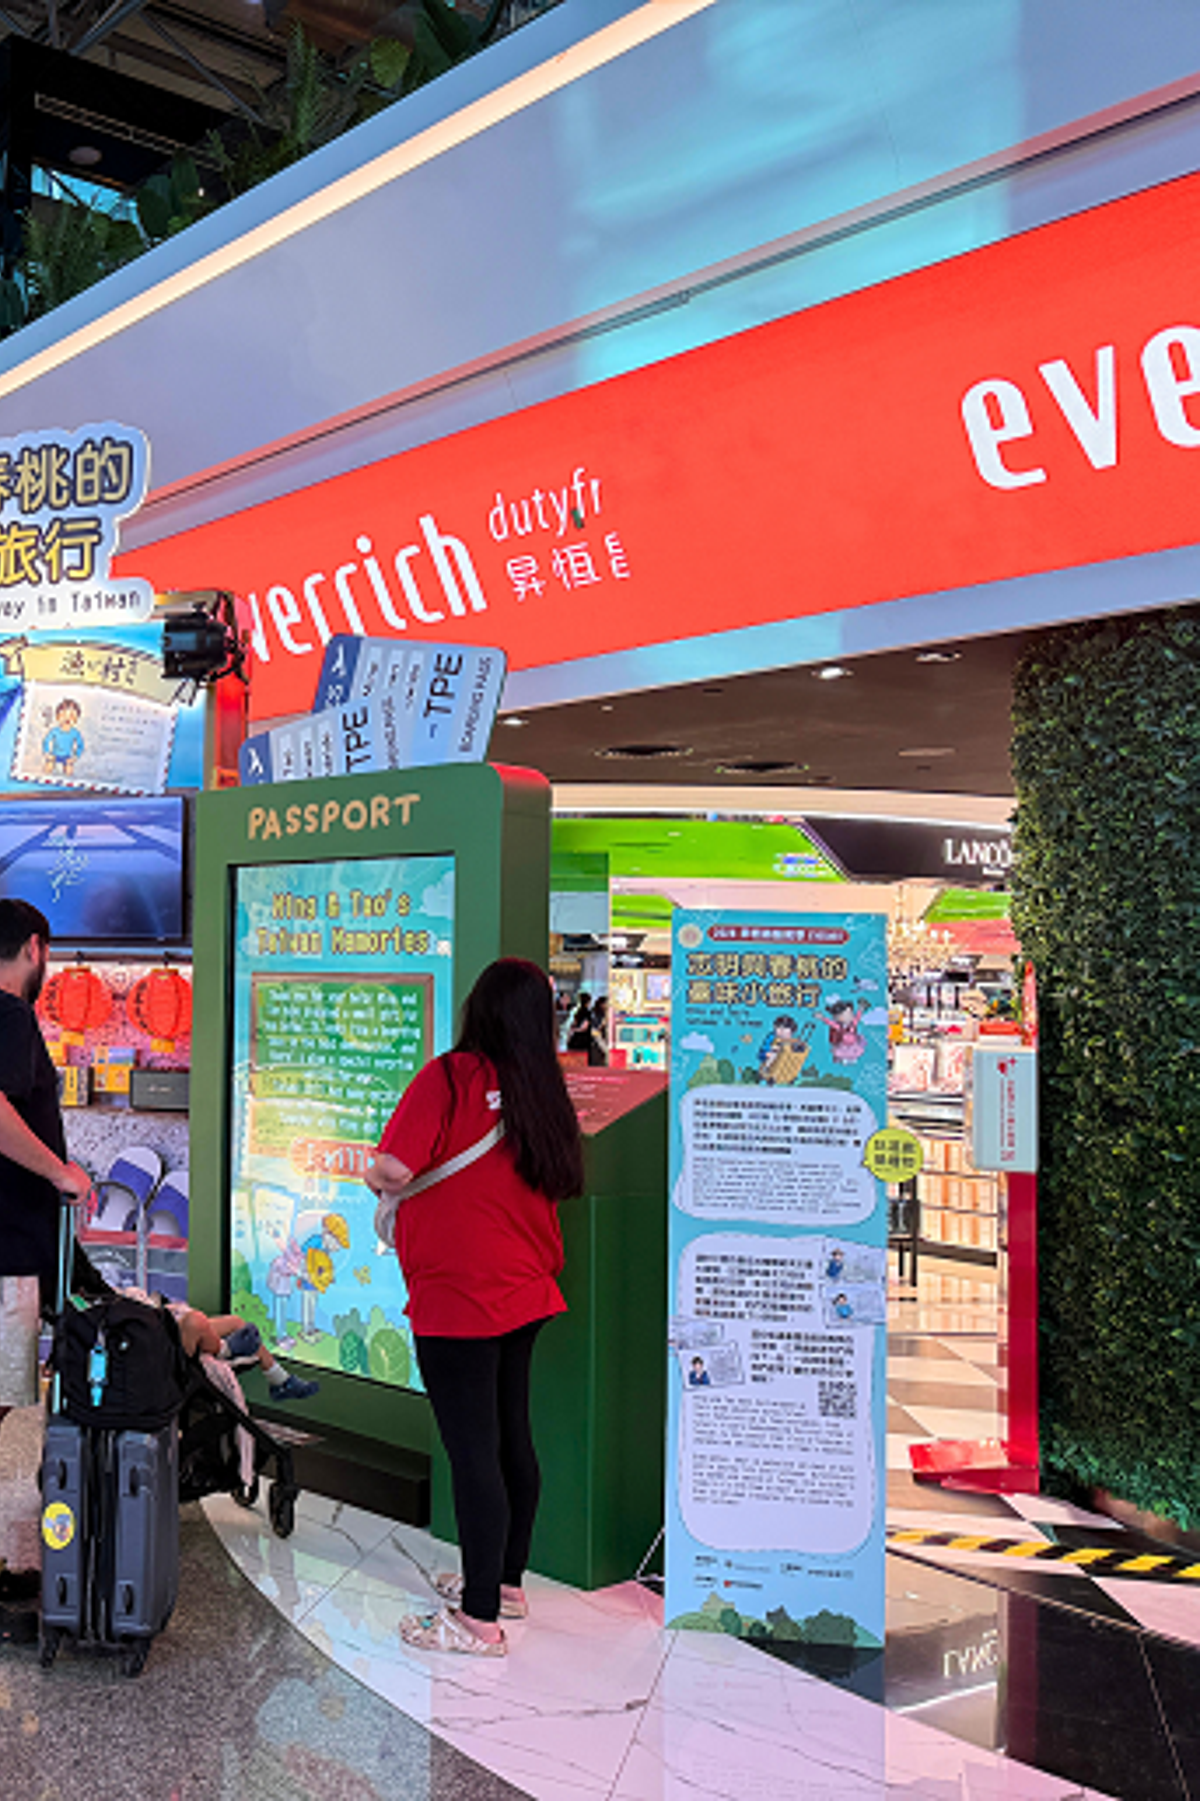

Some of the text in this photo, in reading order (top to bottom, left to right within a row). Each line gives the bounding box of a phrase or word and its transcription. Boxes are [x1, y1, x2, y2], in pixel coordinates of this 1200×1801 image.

[961, 325, 1200, 491] eve
[71, 590, 141, 612] Taiwan
[423, 653, 464, 719] TPE
[341, 706, 374, 773] TPE
[248, 793, 421, 840] PASSPORT
[271, 892, 317, 920] Ming
[332, 927, 430, 955] Memories
